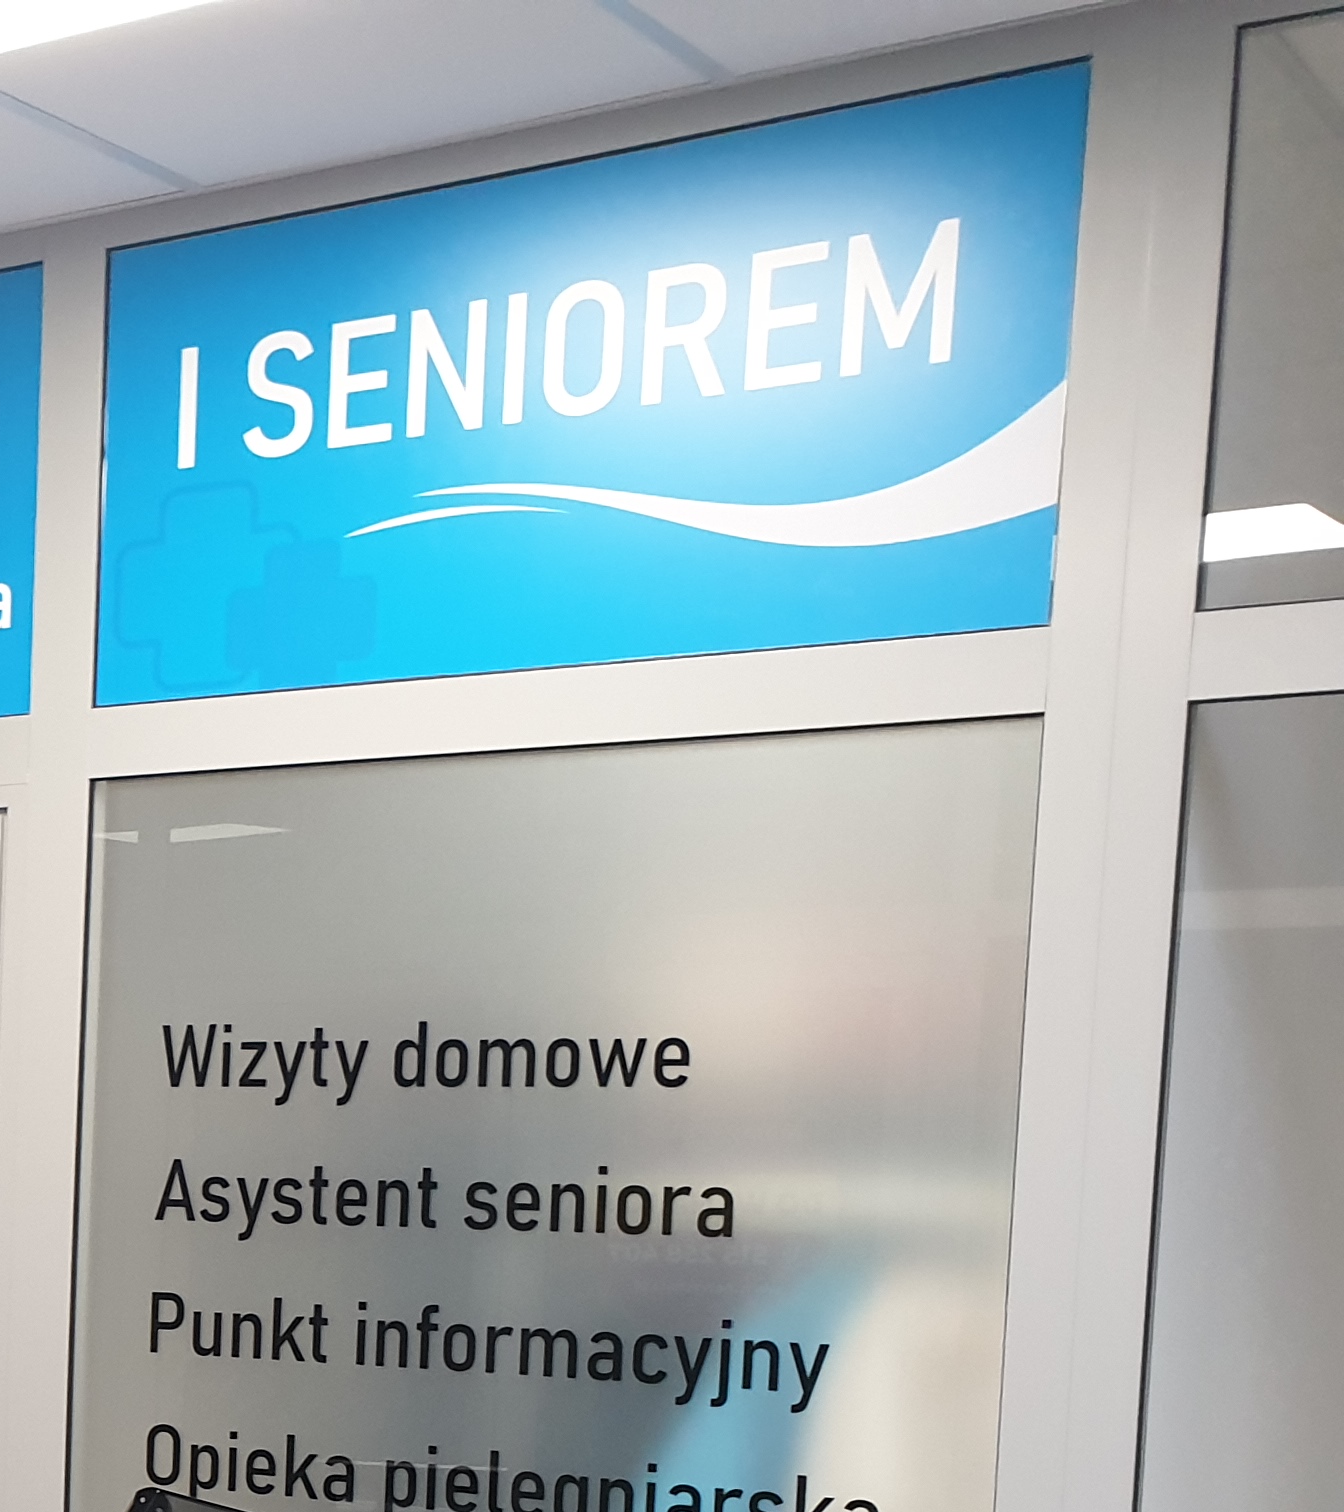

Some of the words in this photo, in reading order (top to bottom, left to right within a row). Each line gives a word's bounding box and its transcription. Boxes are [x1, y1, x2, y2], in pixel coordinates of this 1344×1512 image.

[176, 345, 200, 470] I
[242, 217, 961, 459] SENIOREM
[162, 1024, 369, 1106] Wizyty
[393, 1021, 692, 1089] domowe
[154, 1158, 438, 1241] Asystent
[463, 1165, 735, 1238] seniora
[149, 1291, 329, 1365] Punkt
[354, 1301, 830, 1413] informacyjny
[144, 1423, 355, 1503] Opieka
